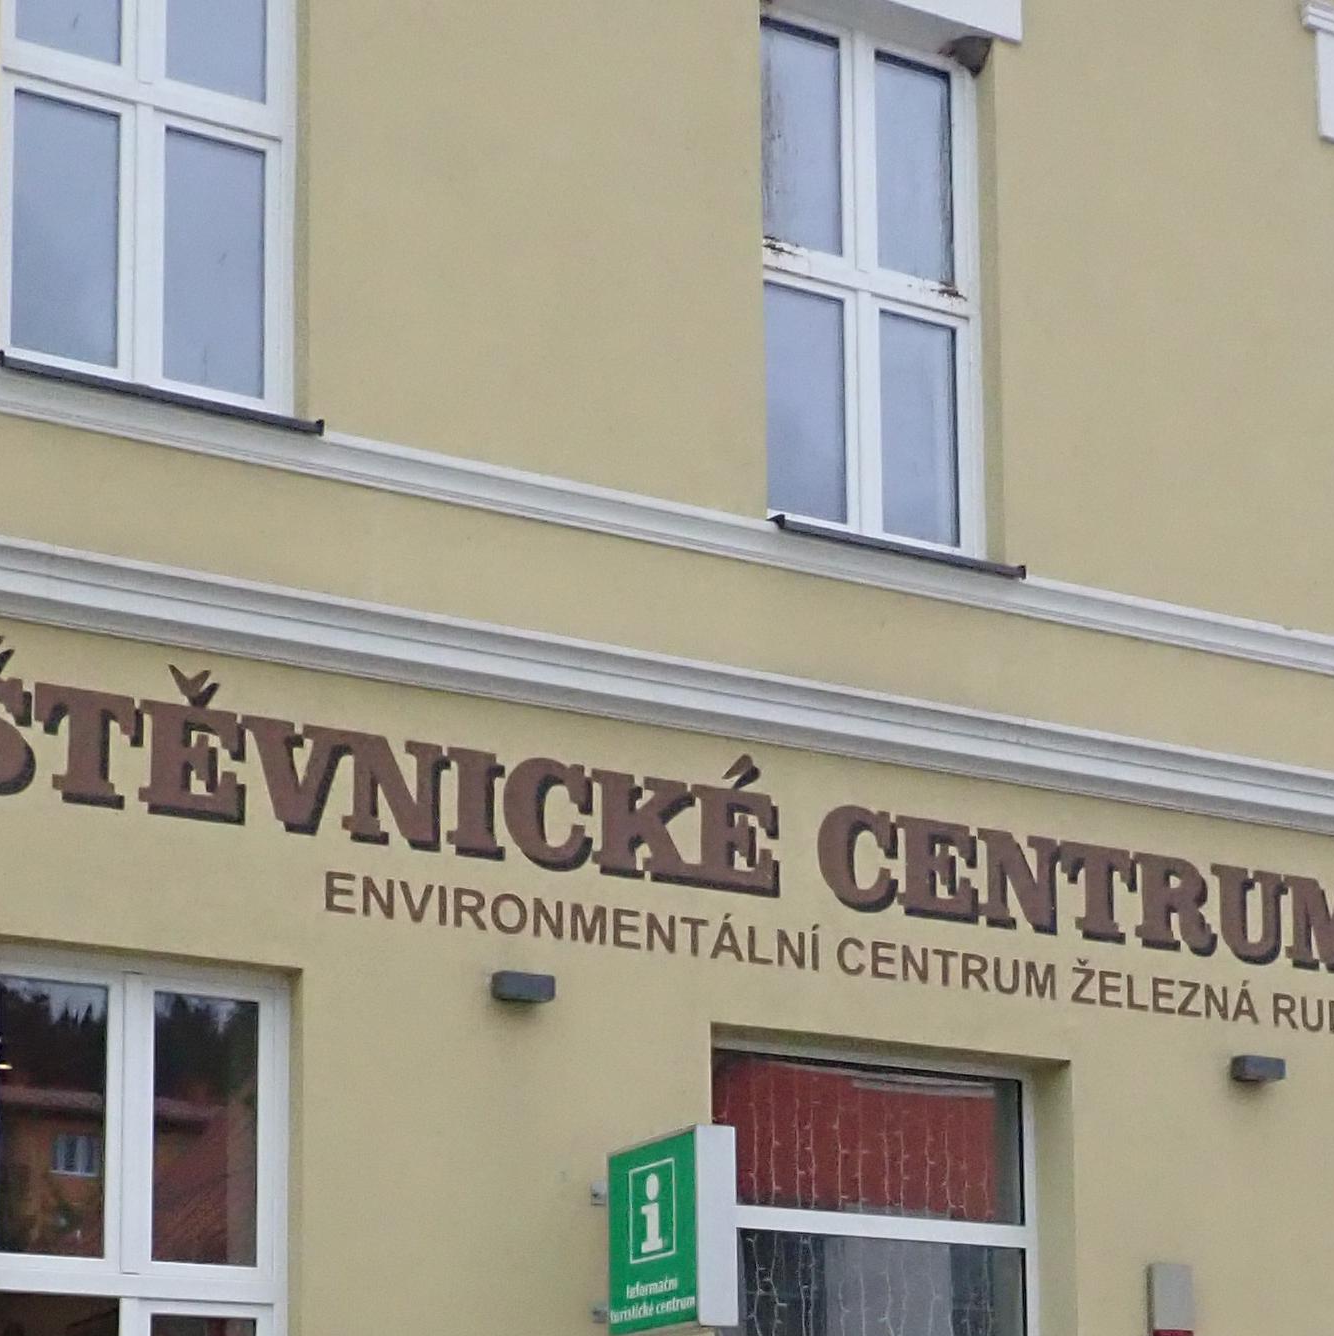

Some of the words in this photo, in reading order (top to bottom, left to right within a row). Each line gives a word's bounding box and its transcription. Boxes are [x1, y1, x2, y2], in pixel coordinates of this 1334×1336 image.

[324, 870, 820, 972] ENVIRONMENTÁLNÍ
[836, 937, 1057, 1000] CENTRUM
[1071, 958, 1259, 1025] ŽELEZNÁ
[655, 1296, 696, 1314] centrum
